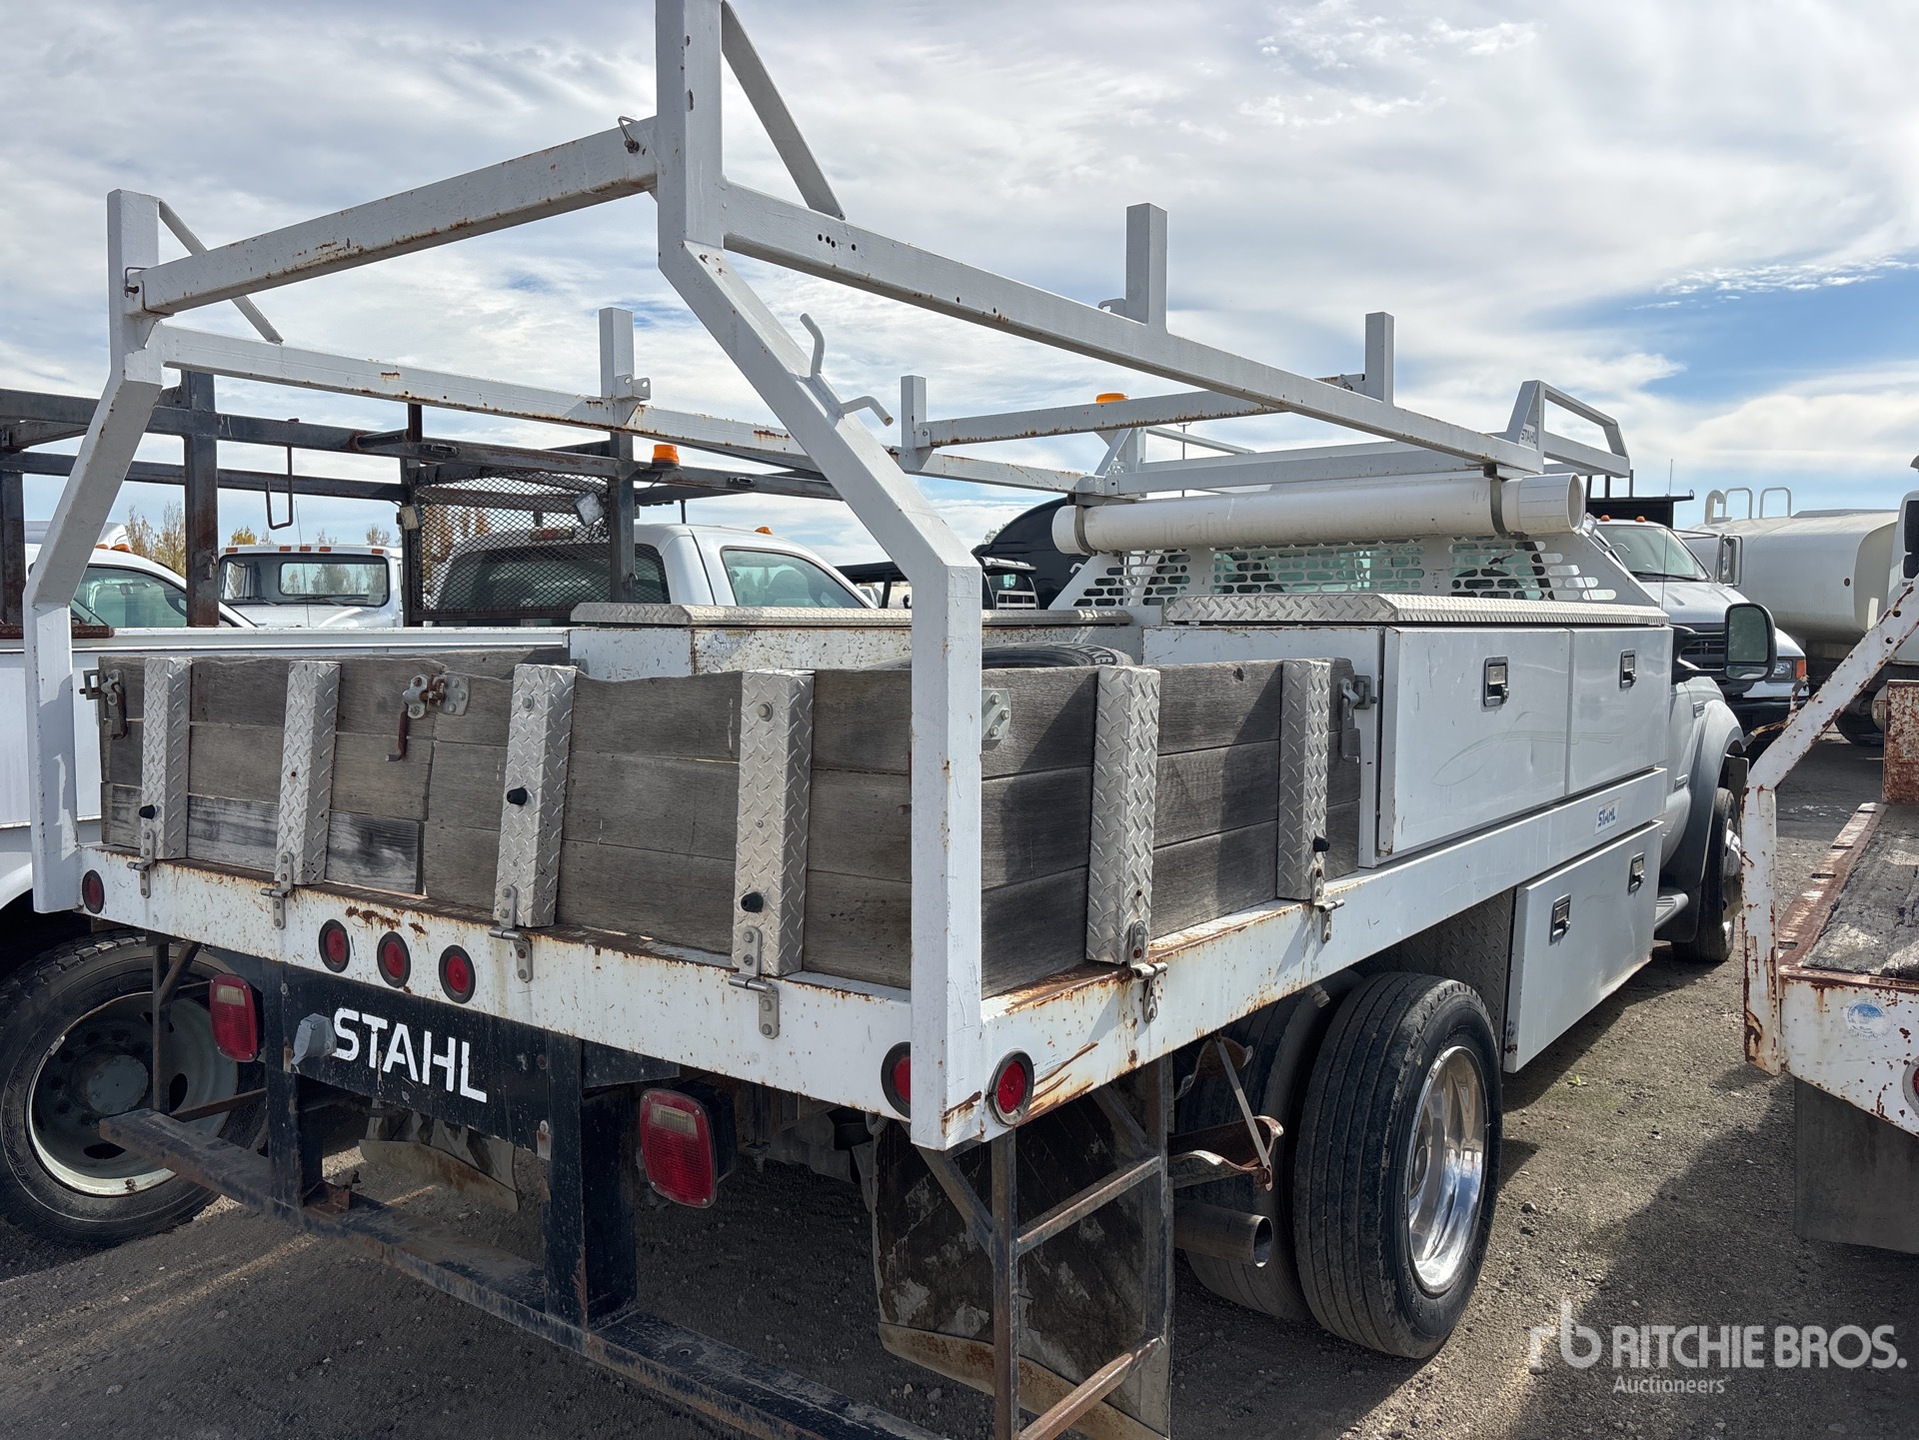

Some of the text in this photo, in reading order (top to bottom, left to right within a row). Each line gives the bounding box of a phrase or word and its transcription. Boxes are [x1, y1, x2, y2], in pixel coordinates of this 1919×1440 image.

[1520, 428, 1537, 444] STAHL
[1597, 807, 1616, 828] STAHL
[332, 1007, 487, 1103] STAHL
